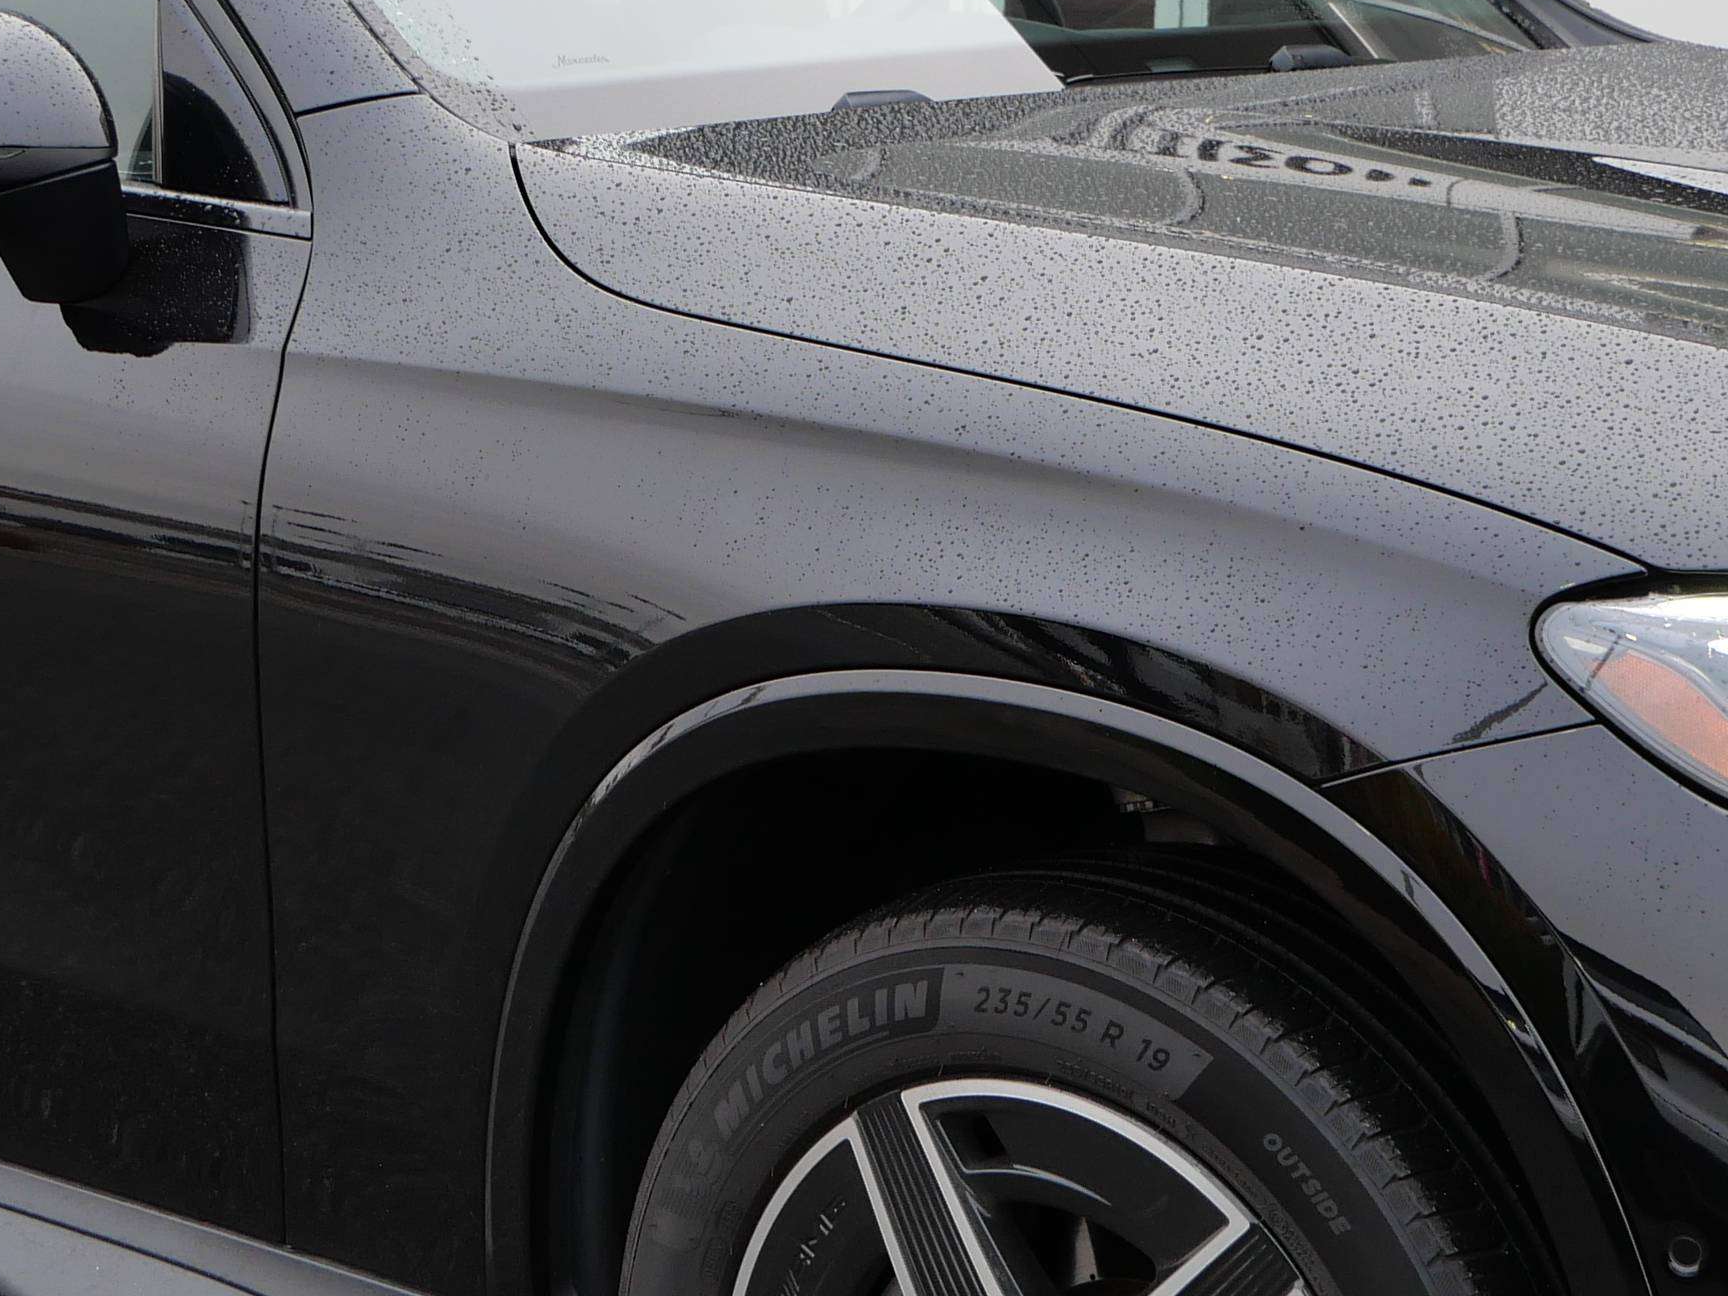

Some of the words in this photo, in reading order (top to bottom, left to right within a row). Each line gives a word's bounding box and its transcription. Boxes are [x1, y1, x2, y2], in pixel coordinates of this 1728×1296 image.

[713, 979, 929, 1141] MICHELIN
[976, 986, 1092, 1034] 235/55
[1100, 1018, 1126, 1050] R
[1135, 1039, 1173, 1073] 19
[1263, 1133, 1352, 1236] OUTSIDE
